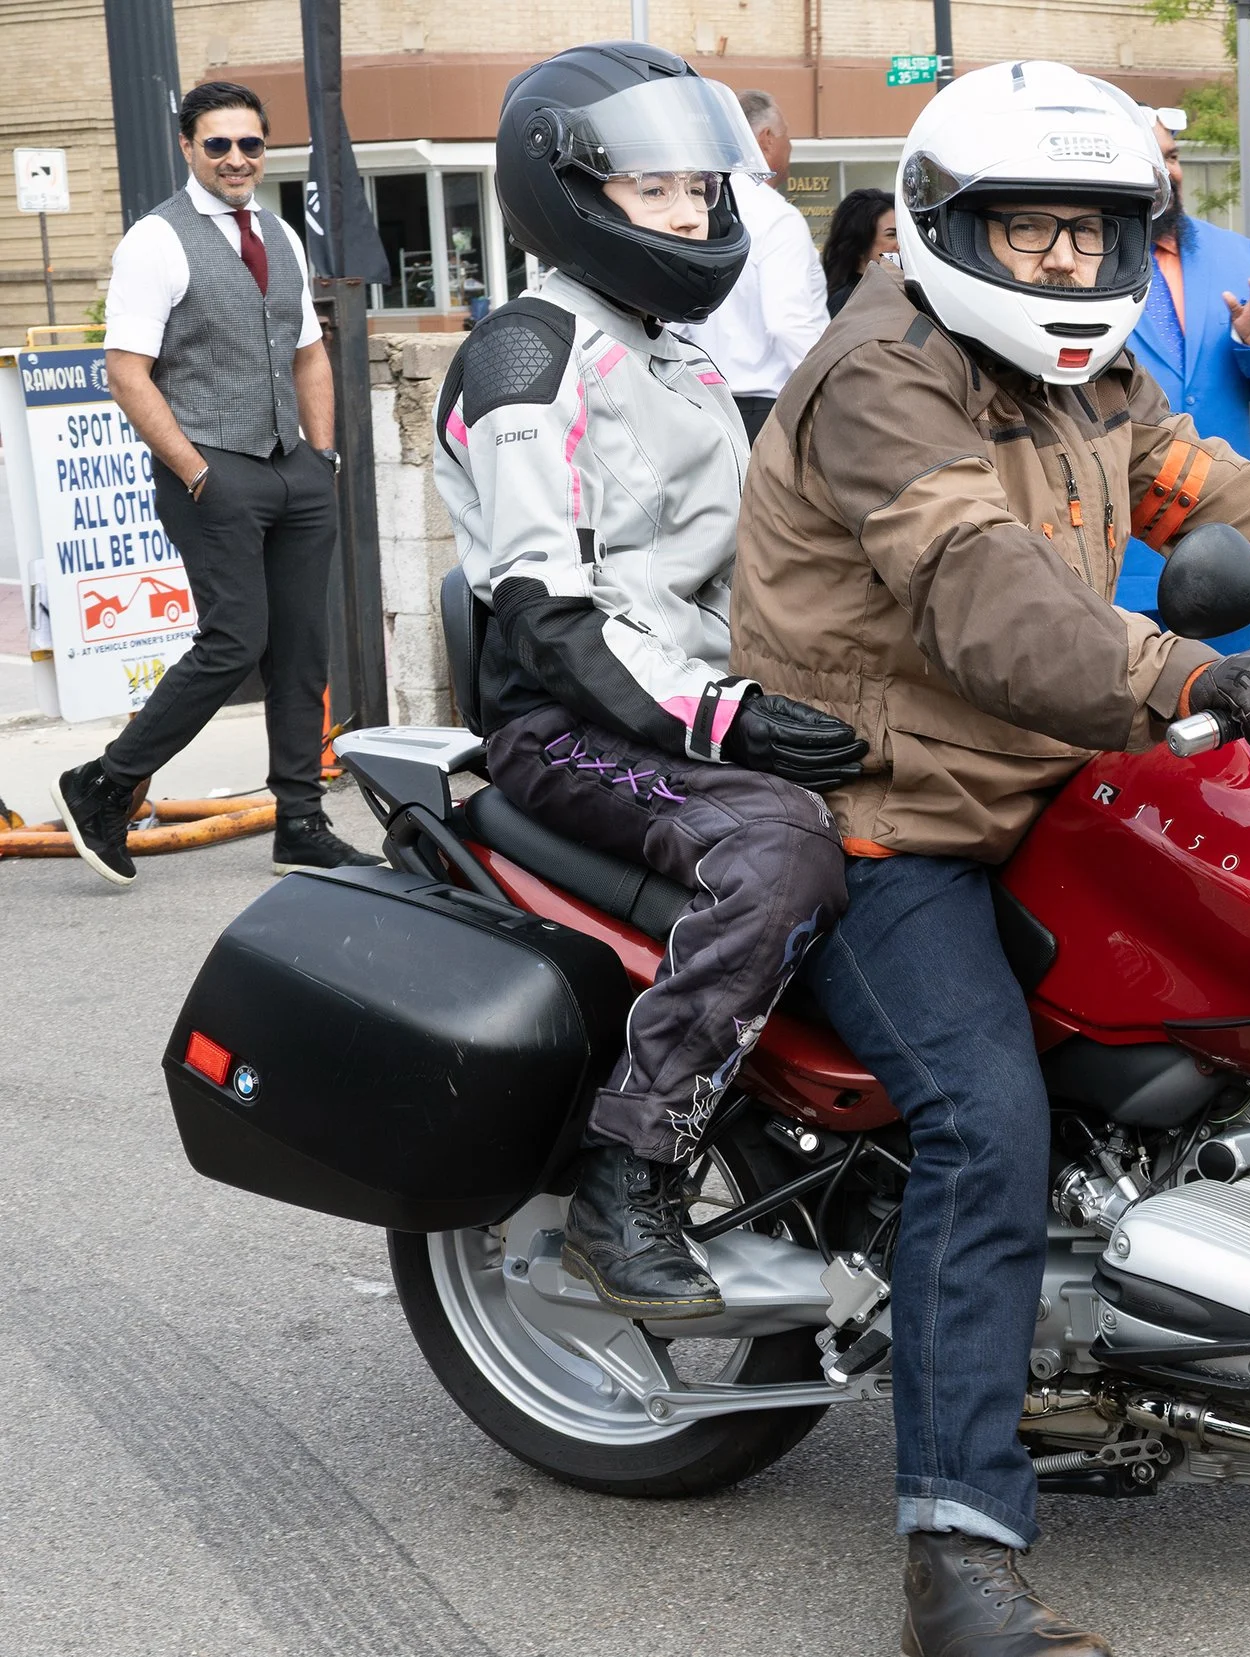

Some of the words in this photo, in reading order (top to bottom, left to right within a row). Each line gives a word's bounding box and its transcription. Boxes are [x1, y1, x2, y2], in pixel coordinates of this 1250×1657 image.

[897, 57, 929, 70] HALSTED
[787, 176, 830, 192] DALEY
[22, 365, 87, 392] RAMOVA
[67, 412, 112, 449] SPOT
[57, 452, 136, 493] PARKING
[74, 495, 109, 531] ALL
[56, 537, 105, 575] WILL
[109, 533, 135, 568] BE
[82, 647, 91, 656] AT
[95, 640, 128, 654] VEHICLE
[130, 635, 164, 648] OWNER'S
[238, 1066, 260, 1085] BMW
